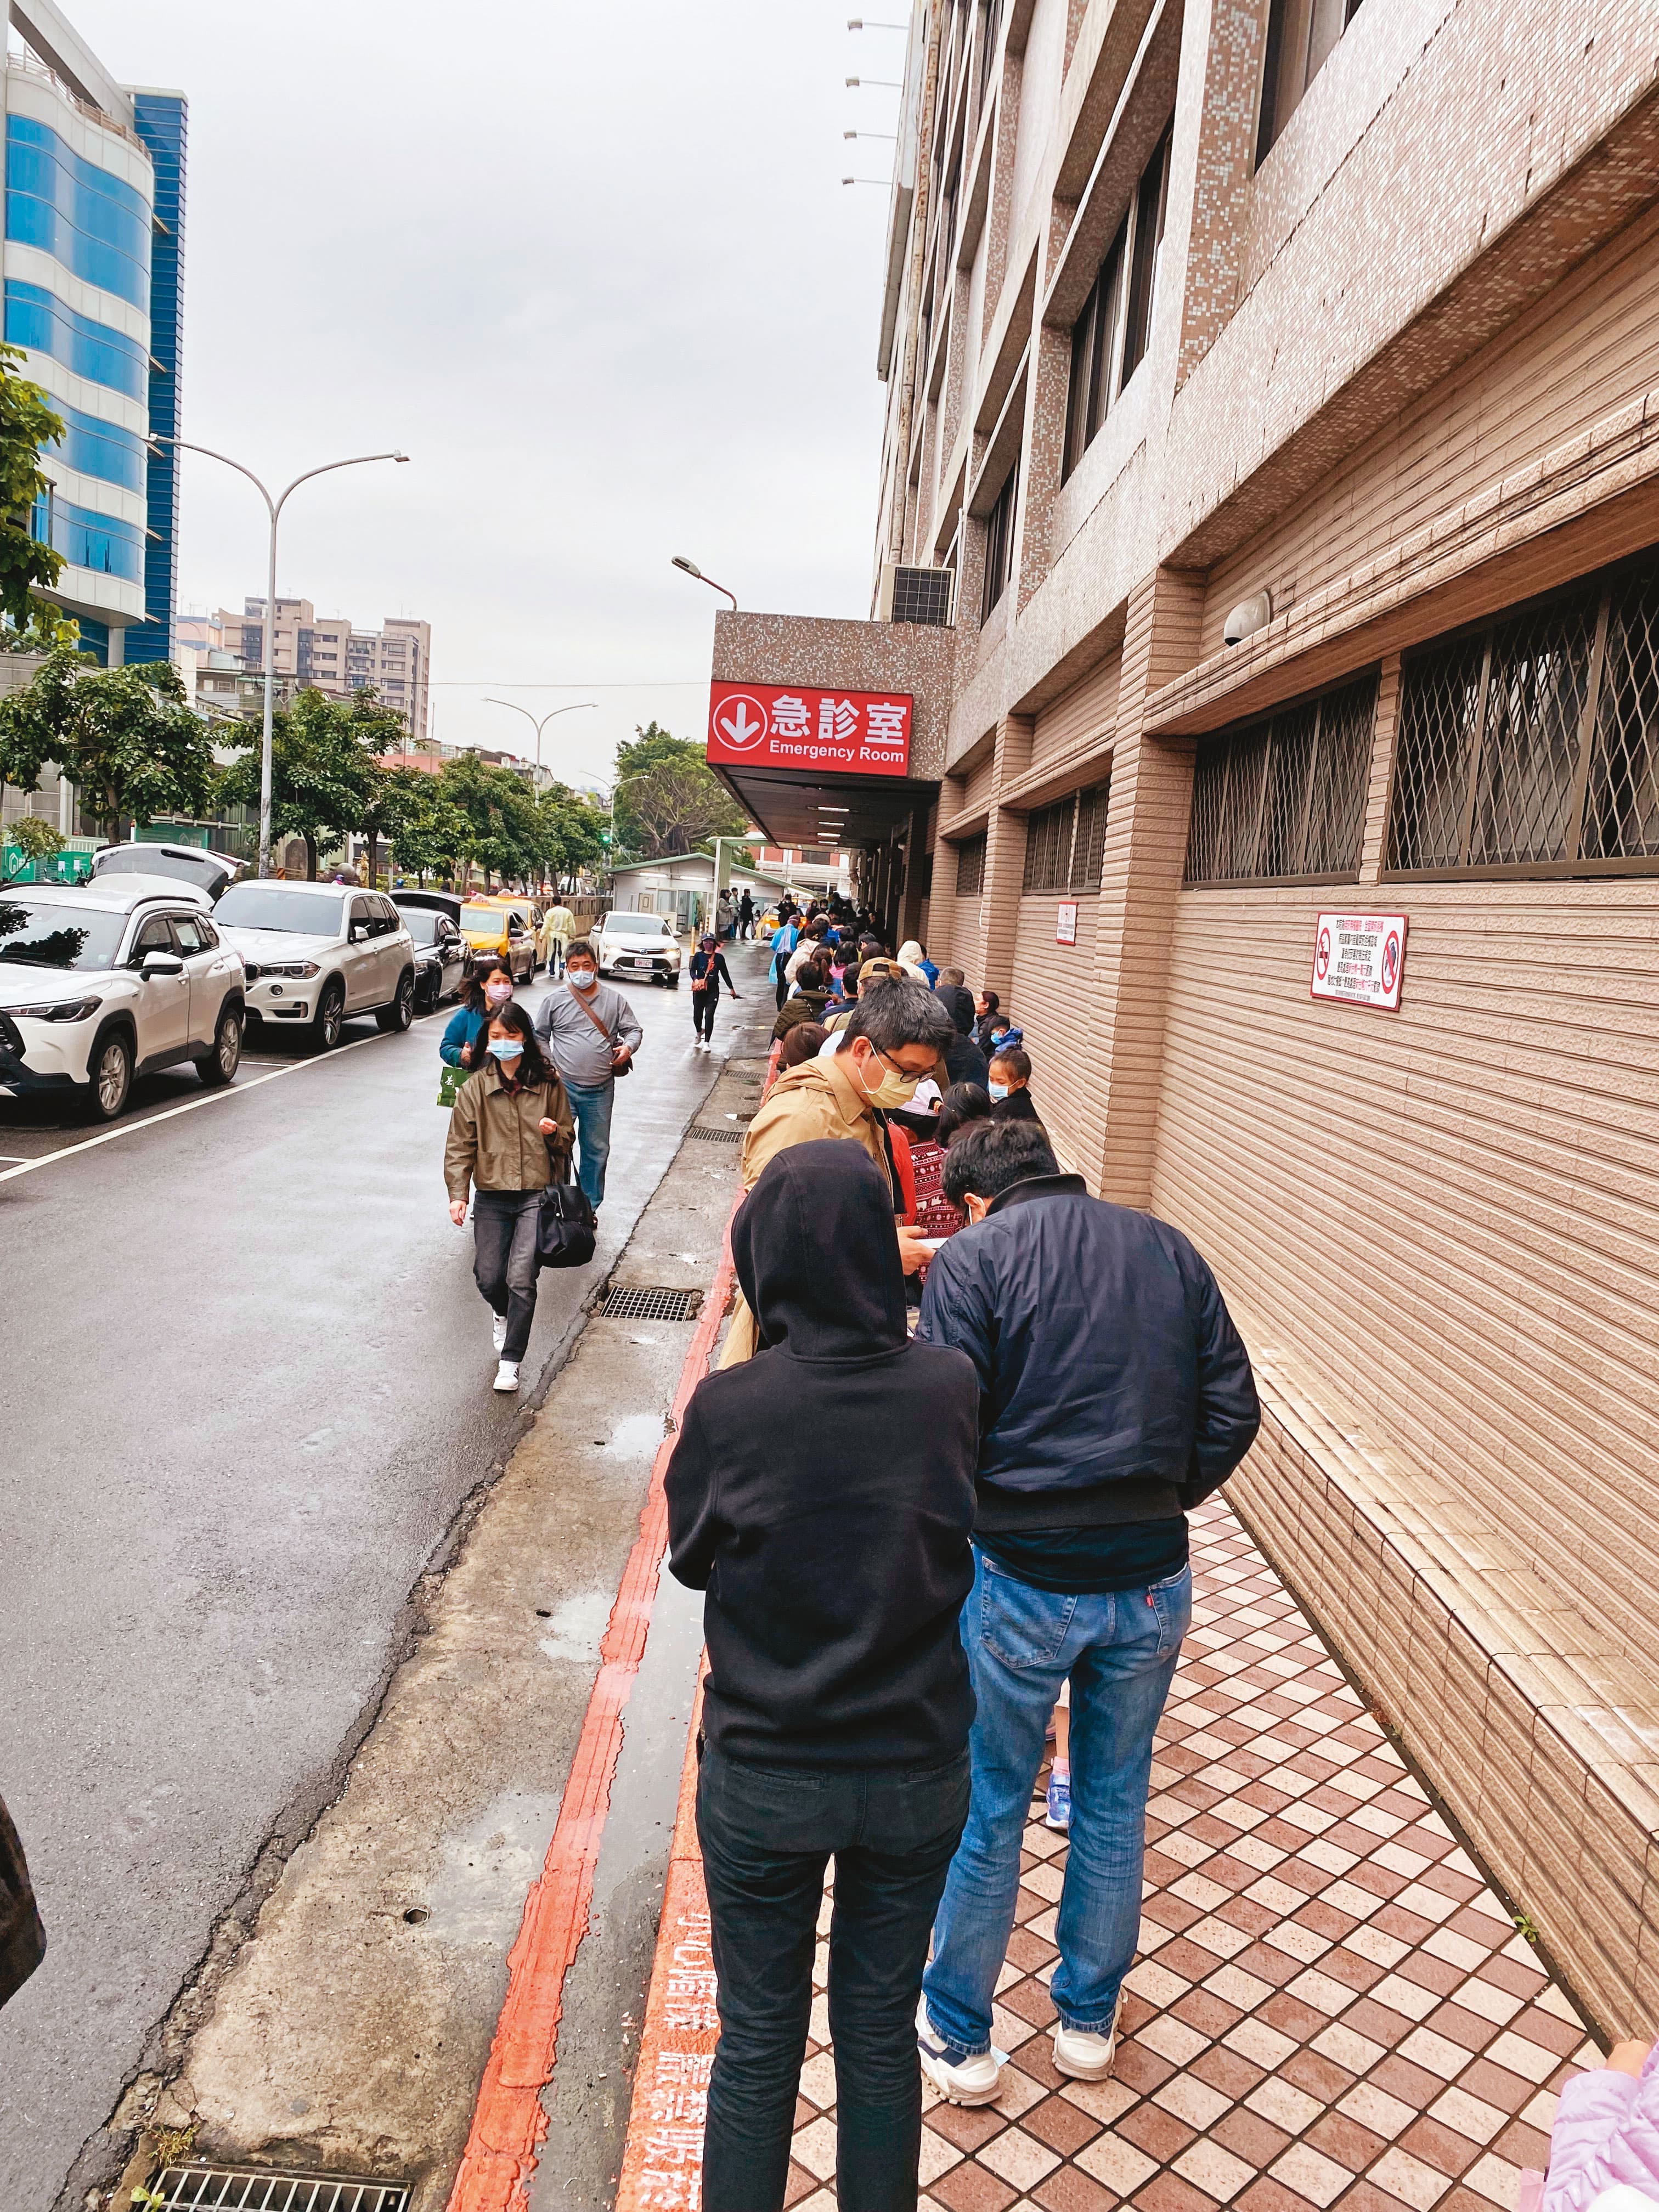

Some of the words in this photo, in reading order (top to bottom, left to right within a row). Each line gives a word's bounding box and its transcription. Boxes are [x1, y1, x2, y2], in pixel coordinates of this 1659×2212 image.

[770, 695, 907, 745] 急診室
[770, 740, 855, 761] Emergency
[860, 747, 904, 763] Room
